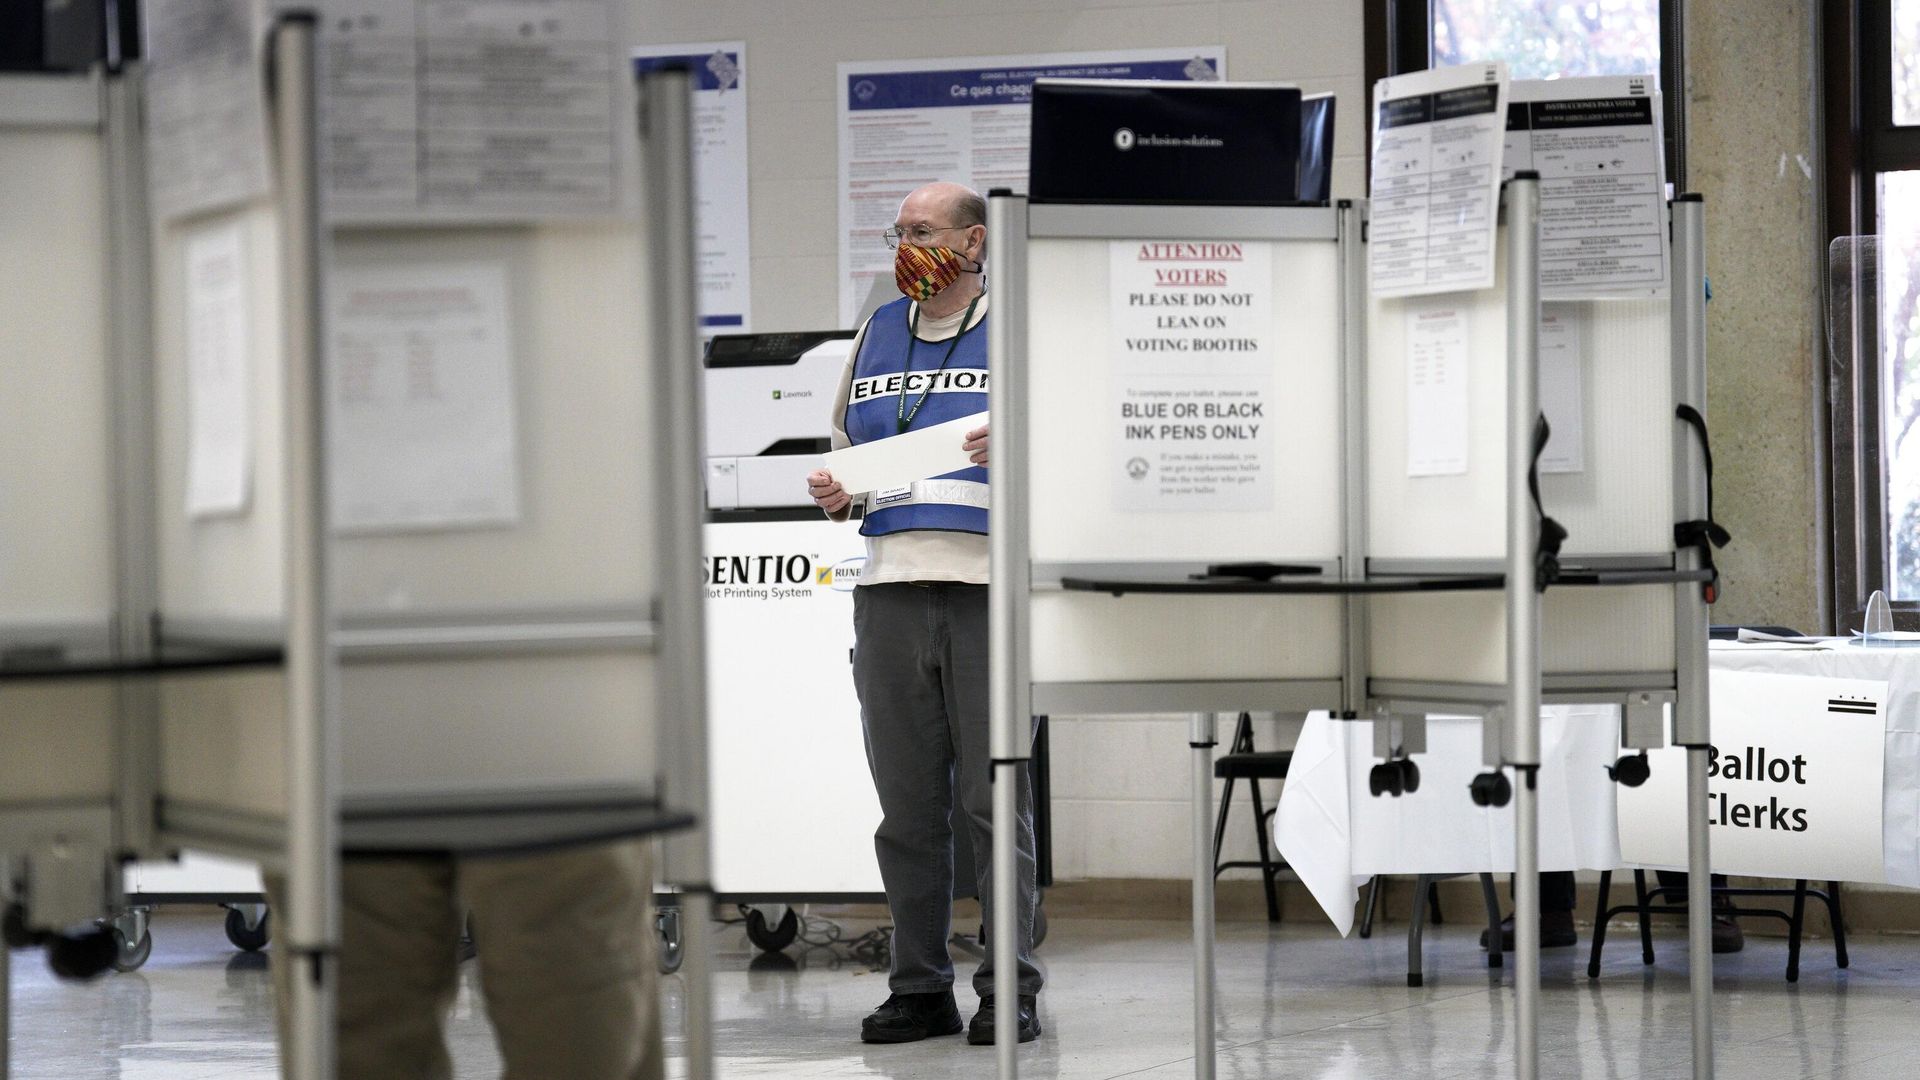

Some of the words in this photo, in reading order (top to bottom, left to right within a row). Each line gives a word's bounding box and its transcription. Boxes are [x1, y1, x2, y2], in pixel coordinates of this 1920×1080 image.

[951, 85, 968, 97] Ce
[970, 85, 993, 98] que
[995, 83, 1032, 97] chaqu
[1138, 243, 1243, 259] ATTENTION
[1155, 268, 1227, 283] VOTERS
[1129, 294, 1189, 306] PLEASE
[1193, 294, 1216, 306] DO
[1220, 294, 1254, 306] NOT
[1157, 316, 1199, 329] LEAN
[1203, 316, 1227, 329] ON
[1125, 339, 1189, 352] VOTING
[1193, 339, 1258, 352] BOOTHS
[783, 390, 812, 399] Lexmark
[1121, 403, 1168, 419] BLUE
[1172, 403, 1199, 419] OR
[1204, 403, 1263, 419] BLACK
[1125, 425, 1155, 440] INK
[1160, 425, 1207, 440] PENS
[1212, 425, 1260, 440] ONLY
[835, 568, 861, 577] RUNB
[704, 588, 721, 598] llot
[724, 587, 767, 600] Printing
[771, 587, 812, 600] System
